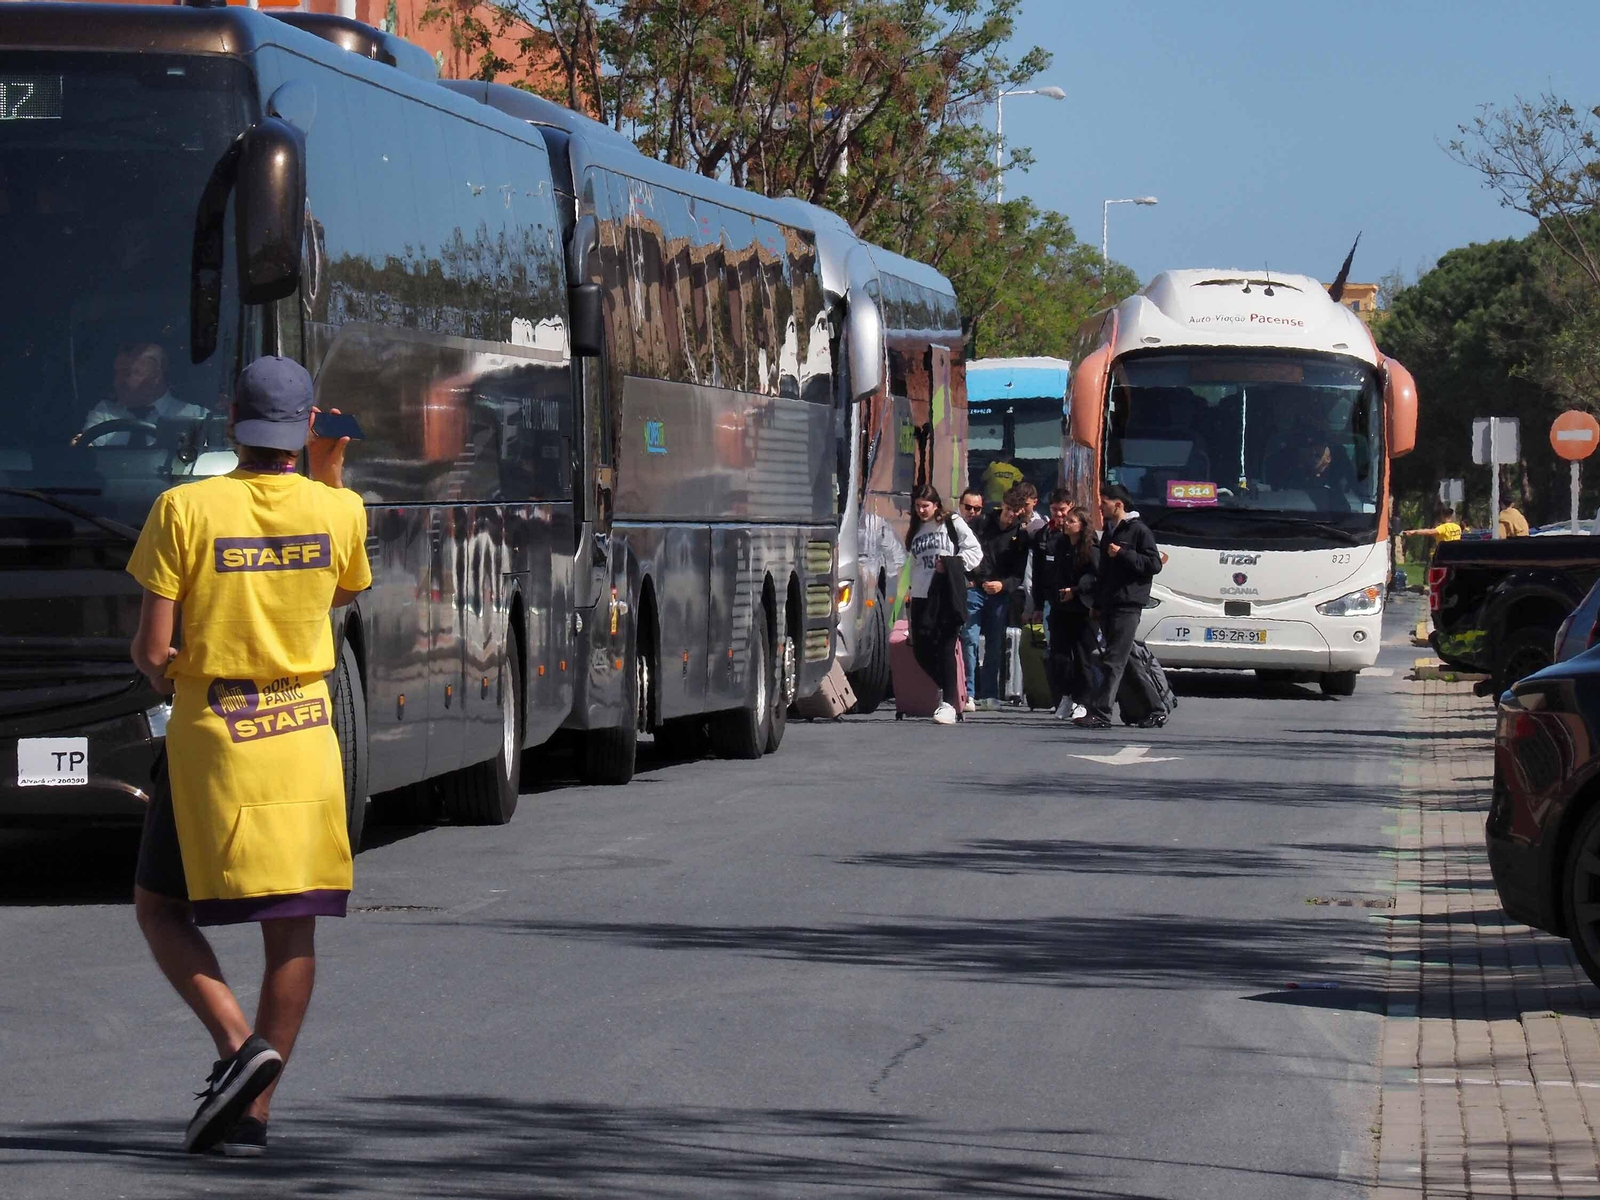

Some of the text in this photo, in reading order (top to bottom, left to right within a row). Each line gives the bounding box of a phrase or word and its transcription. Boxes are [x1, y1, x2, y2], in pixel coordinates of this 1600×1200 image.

[1250, 313, 1304, 327] Pacense
[222, 544, 321, 567] STAFF
[1332, 553, 1351, 565] 823
[1219, 586, 1259, 596] SCANIA
[1175, 627, 1191, 637] TP
[265, 683, 304, 706] PANIC
[234, 704, 322, 738] STAFF
[51, 751, 85, 772] TP
